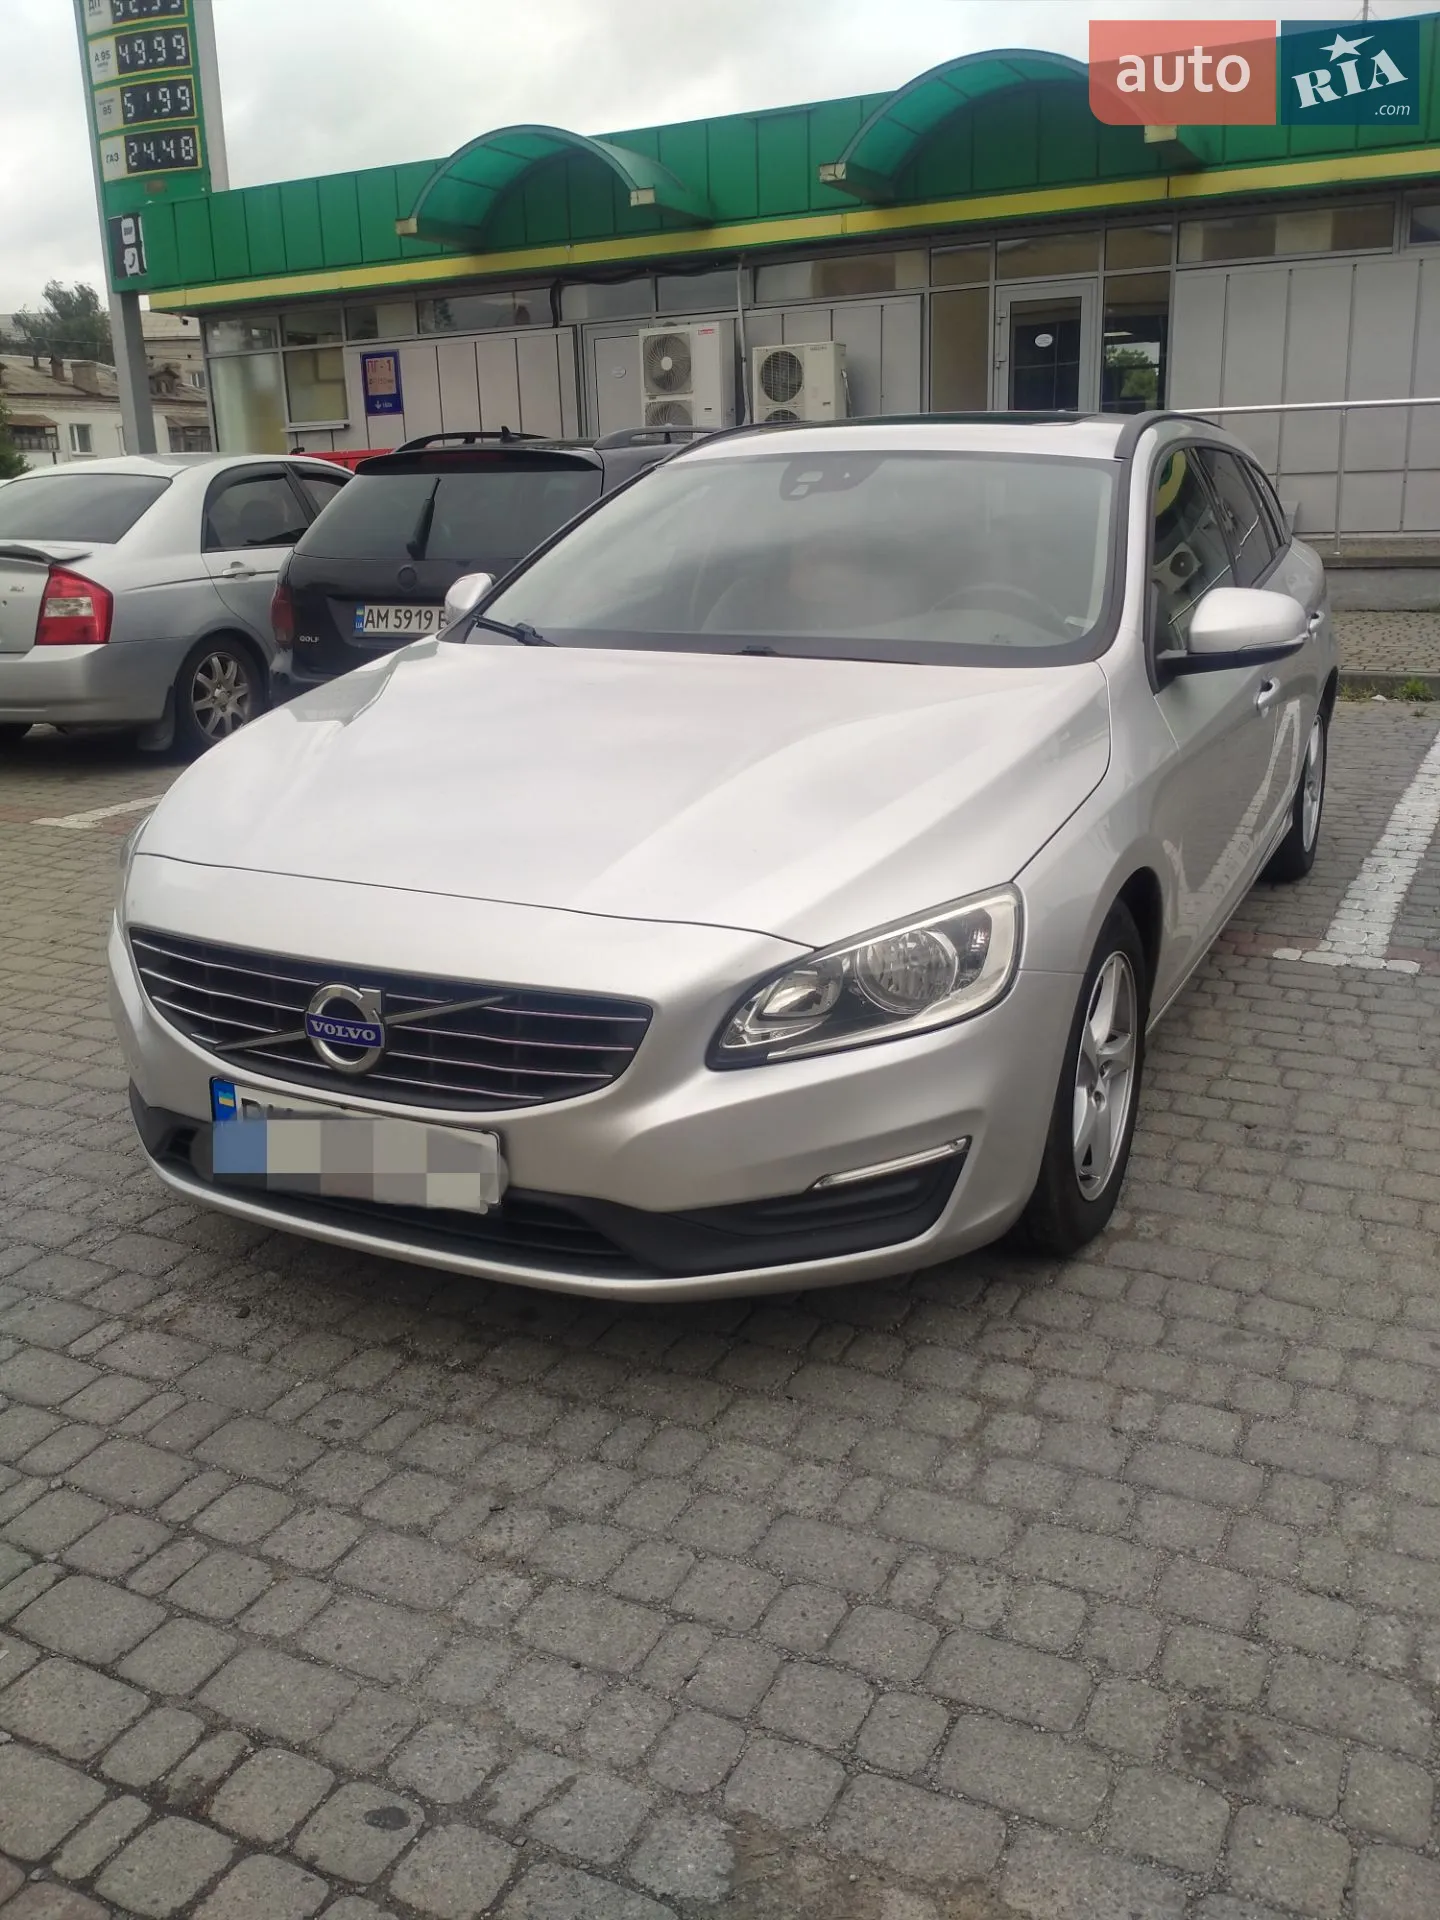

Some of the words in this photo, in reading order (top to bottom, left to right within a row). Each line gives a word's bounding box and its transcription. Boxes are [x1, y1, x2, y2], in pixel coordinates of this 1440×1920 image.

[118, 34, 186, 65] 49.99
[106, 152, 120, 164] ГАЗ
[128, 135, 194, 166] 24.48
[365, 608, 389, 630] AM
[393, 608, 434, 631] 5919
[299, 634, 320, 643] GOLF
[309, 1019, 376, 1042] VOLVO
